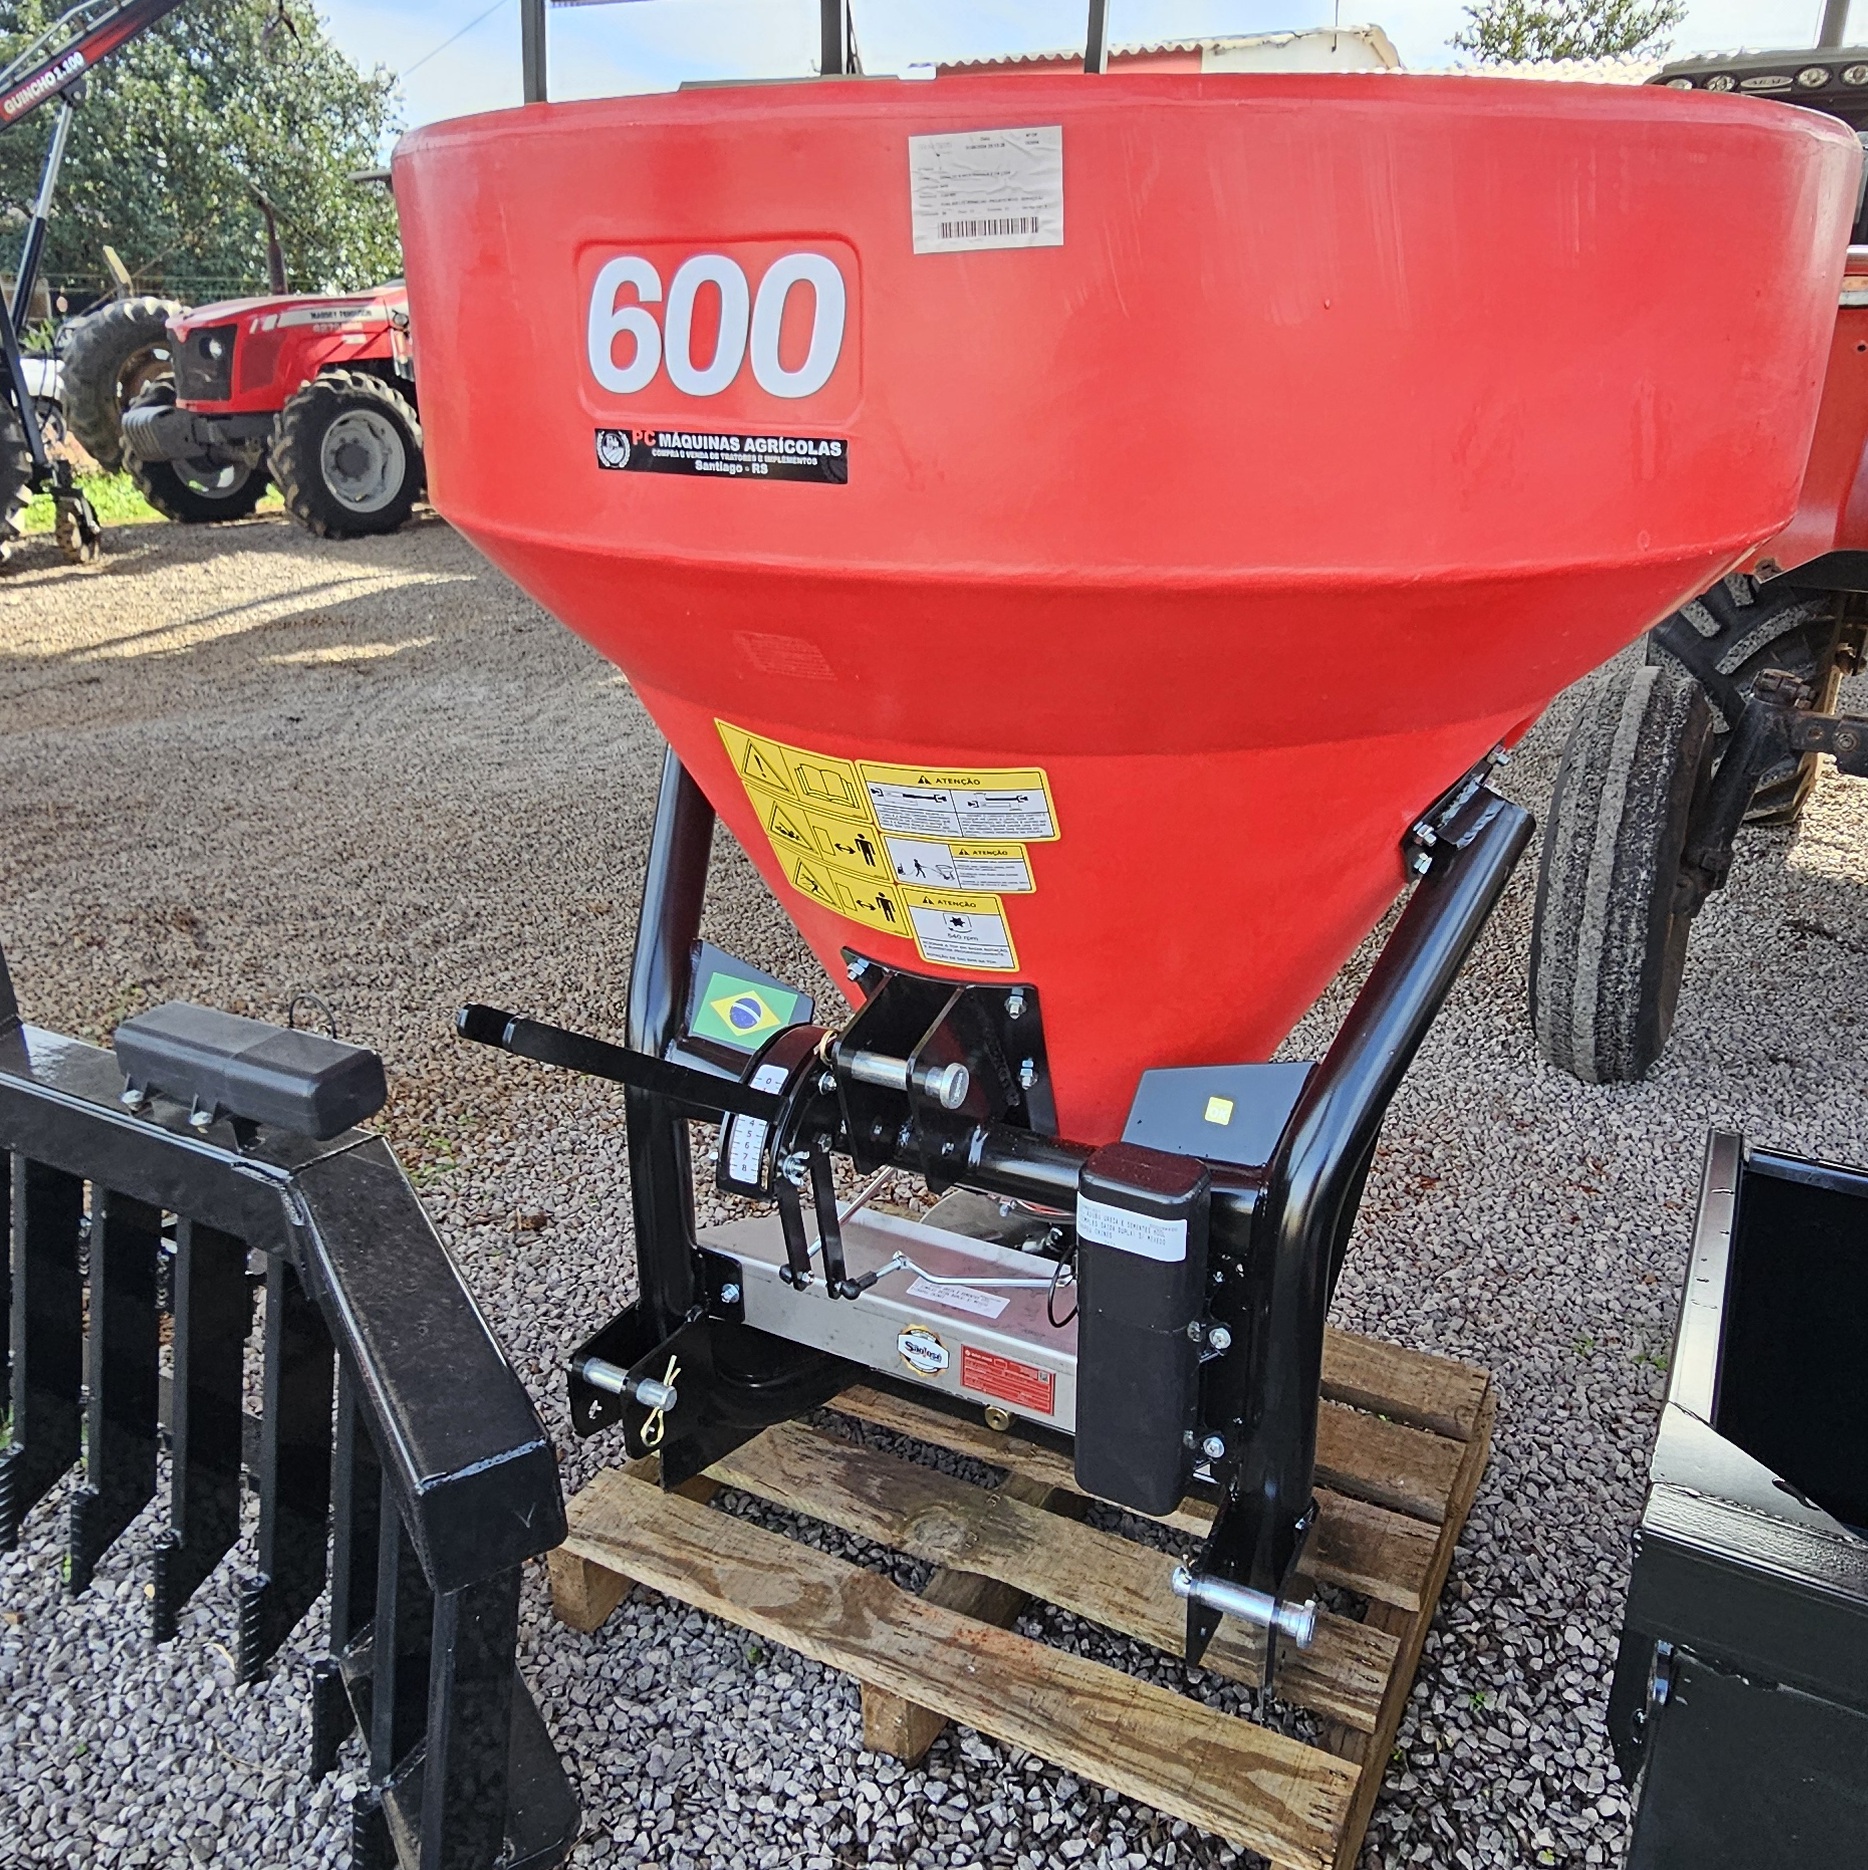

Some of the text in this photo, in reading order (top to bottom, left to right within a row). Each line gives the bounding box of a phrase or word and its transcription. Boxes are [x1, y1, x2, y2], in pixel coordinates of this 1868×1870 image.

[4, 70, 57, 115] GUINCHO
[587, 253, 846, 398] 600
[632, 430, 842, 456] PC MÁQUINAS AGRÍCOLAS
[695, 459, 743, 475] Santiago
[751, 463, 768, 474] RS
[935, 777, 981, 786] ATENÇÃO
[937, 899, 977, 908] ATENÇÃO
[947, 932, 979, 942] 540 rpm
[765, 1077, 772, 1085] 0
[746, 1130, 752, 1138] 5
[741, 1164, 747, 1172] 8
